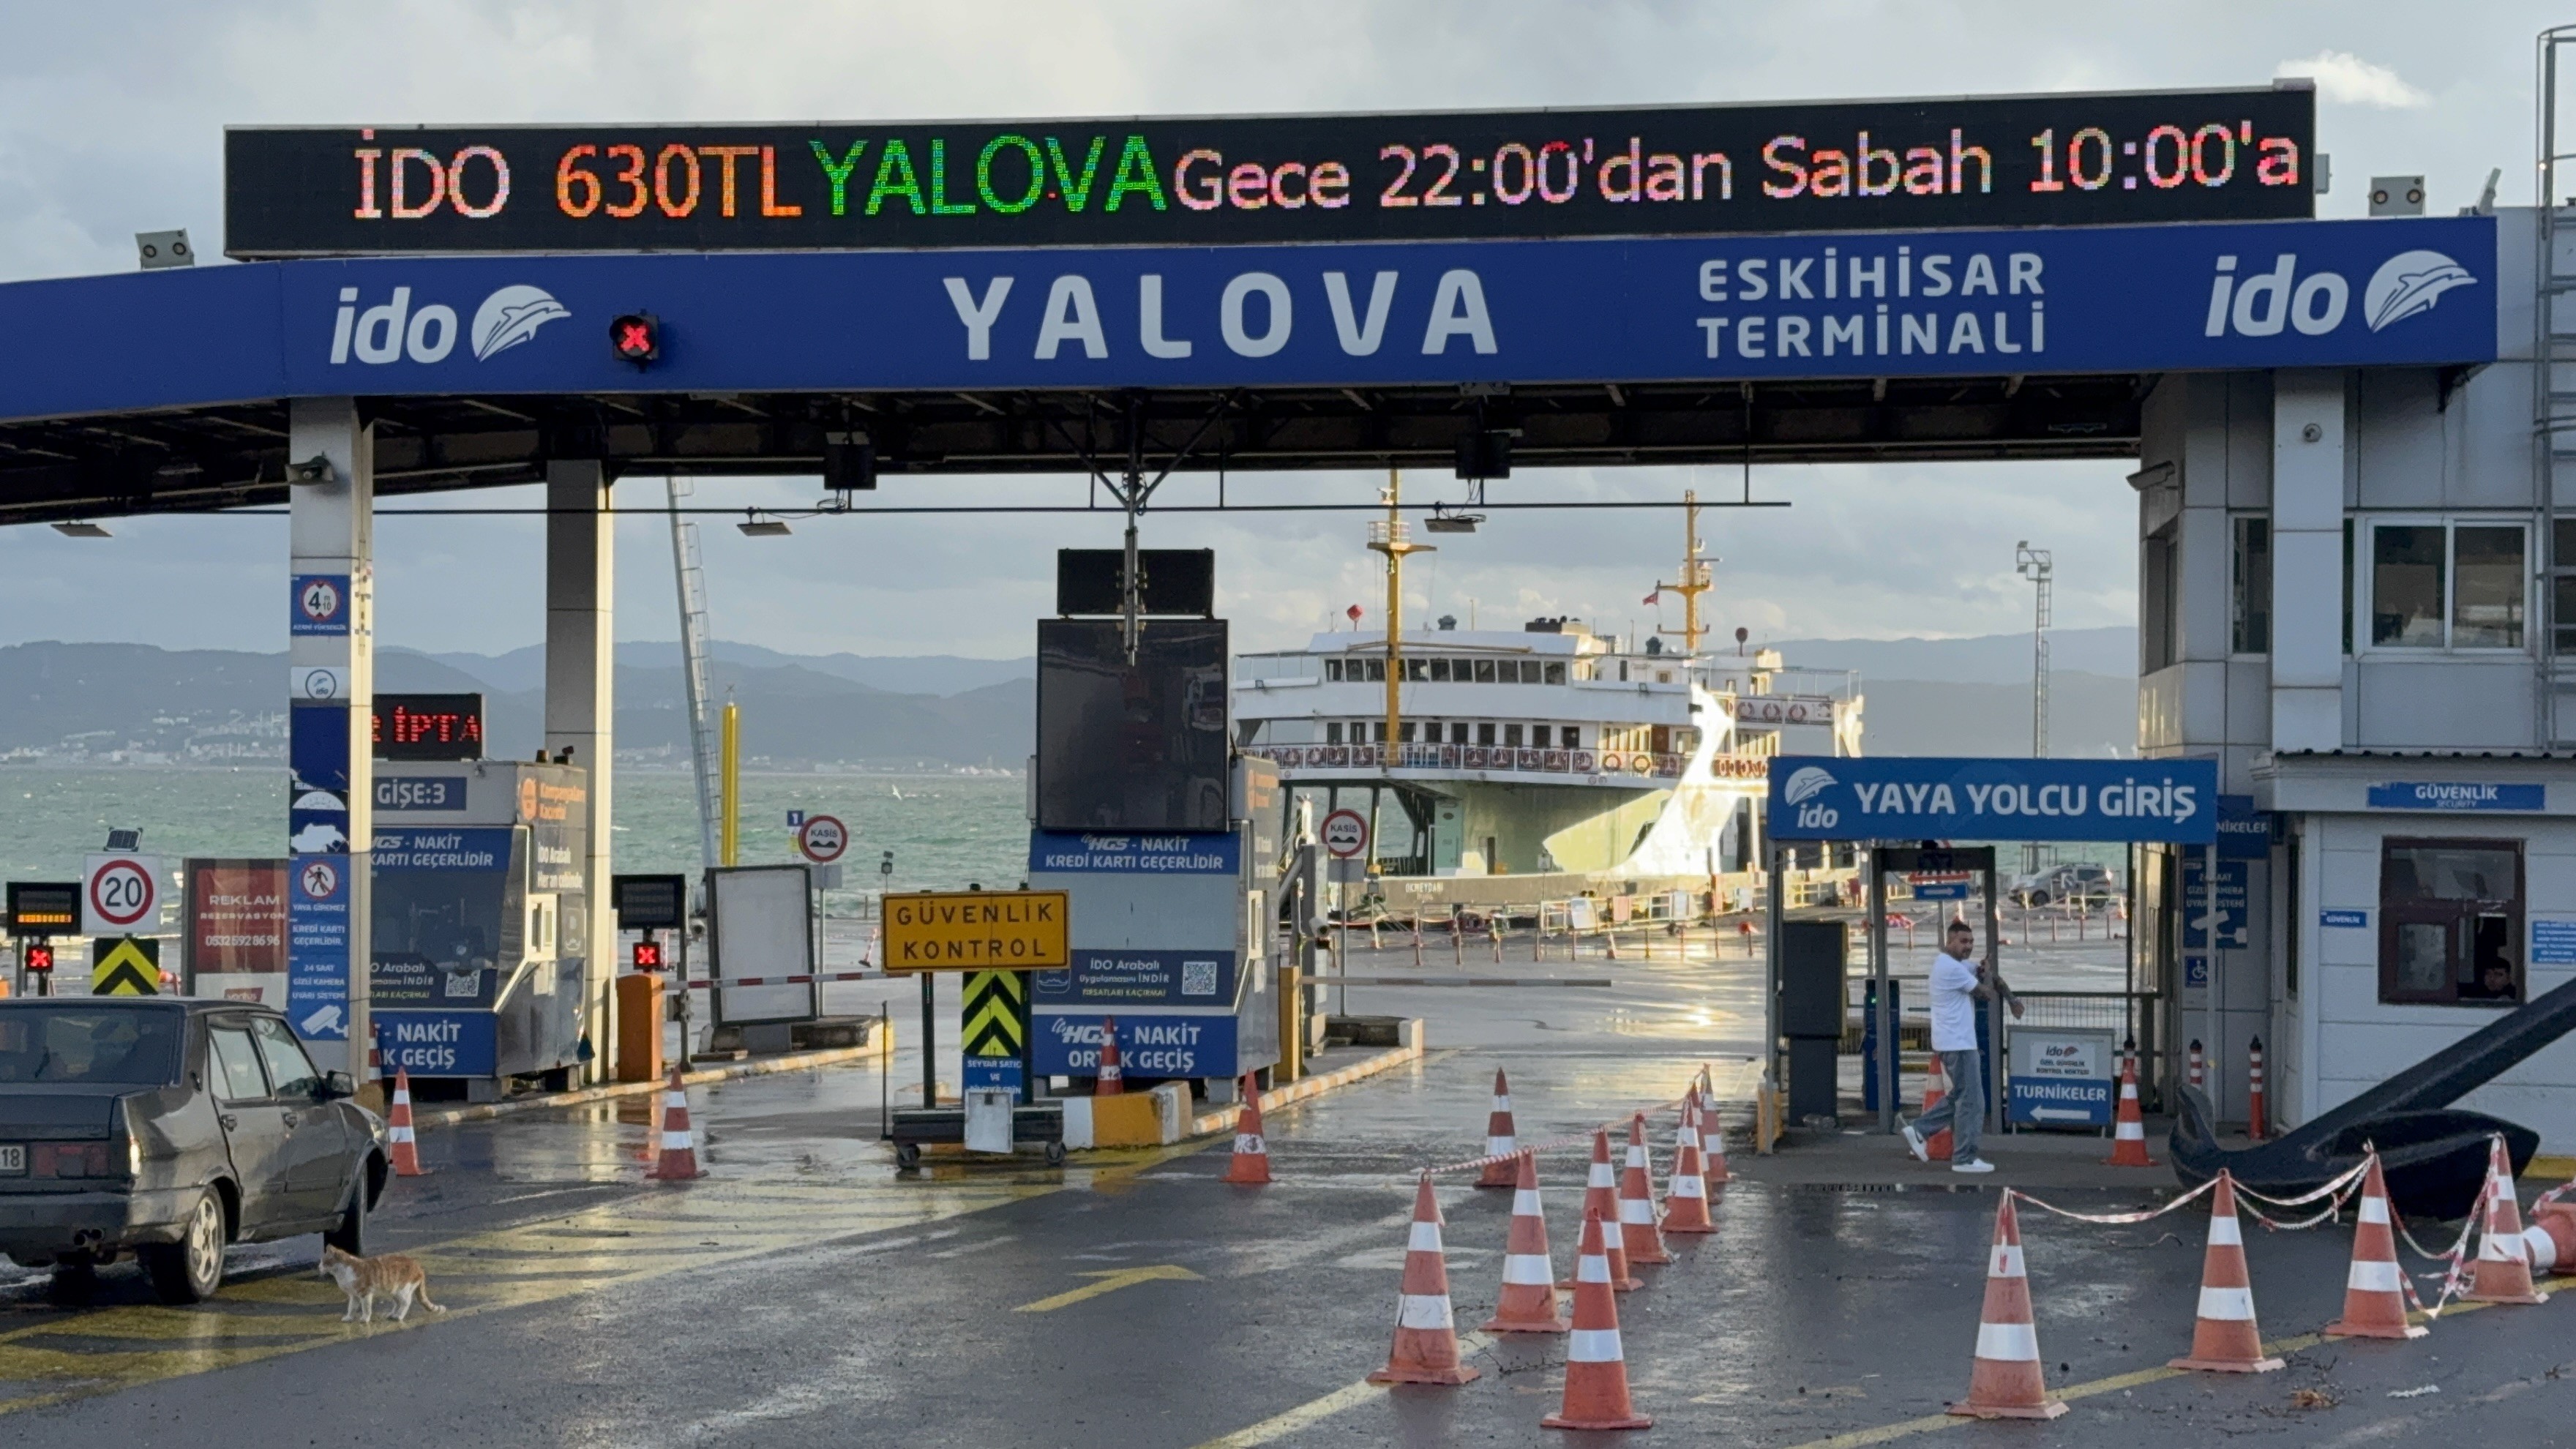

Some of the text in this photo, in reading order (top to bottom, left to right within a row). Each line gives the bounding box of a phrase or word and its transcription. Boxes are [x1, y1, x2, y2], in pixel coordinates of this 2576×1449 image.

[354, 121, 2299, 219] İDO 630TL YALOVA Gece 22:00'dan Sabah 10:00'a
[1699, 245, 2045, 302] ESKİHİSAR
[2204, 253, 2349, 338] ido
[943, 269, 1498, 361] YALOVA
[330, 287, 457, 364] ido
[1696, 301, 2045, 359] TERMİNALİ
[308, 591, 321, 610] 4
[323, 602, 332, 611] 10
[377, 779, 446, 809] GİŞE:3
[2415, 784, 2498, 801] GÜVENLİK
[1798, 777, 2196, 828] ido YAYA YOLCU GİRİŞ
[810, 828, 838, 838] KASİS
[1330, 823, 1358, 834] KASİS
[2216, 820, 2267, 834] NİKELE
[414, 833, 462, 850] NAKİT
[1140, 836, 1190, 851] NAKİT
[412, 851, 494, 869] GEÇERLİDİR
[1045, 853, 1224, 870] KREDİ KARTI GEÇERLİDİR
[105, 876, 142, 907] 20
[209, 895, 280, 905] REKLAM
[896, 899, 1052, 926] GÜVENLİK
[293, 924, 345, 933] KREDİ KARTI
[903, 938, 1046, 960] KONTROL
[383, 962, 425, 973] Arabalı
[1090, 958, 1159, 971] İDO Arabalı
[1138, 973, 1169, 983] İNDİR
[397, 1020, 462, 1042] NAKİT
[1134, 1022, 1202, 1046] NAKİT
[401, 1045, 456, 1070] GEÇİŞ
[1068, 1049, 1195, 1073] ORTK GEÇİŞ
[2014, 1083, 2106, 1102] TURNİKELER
